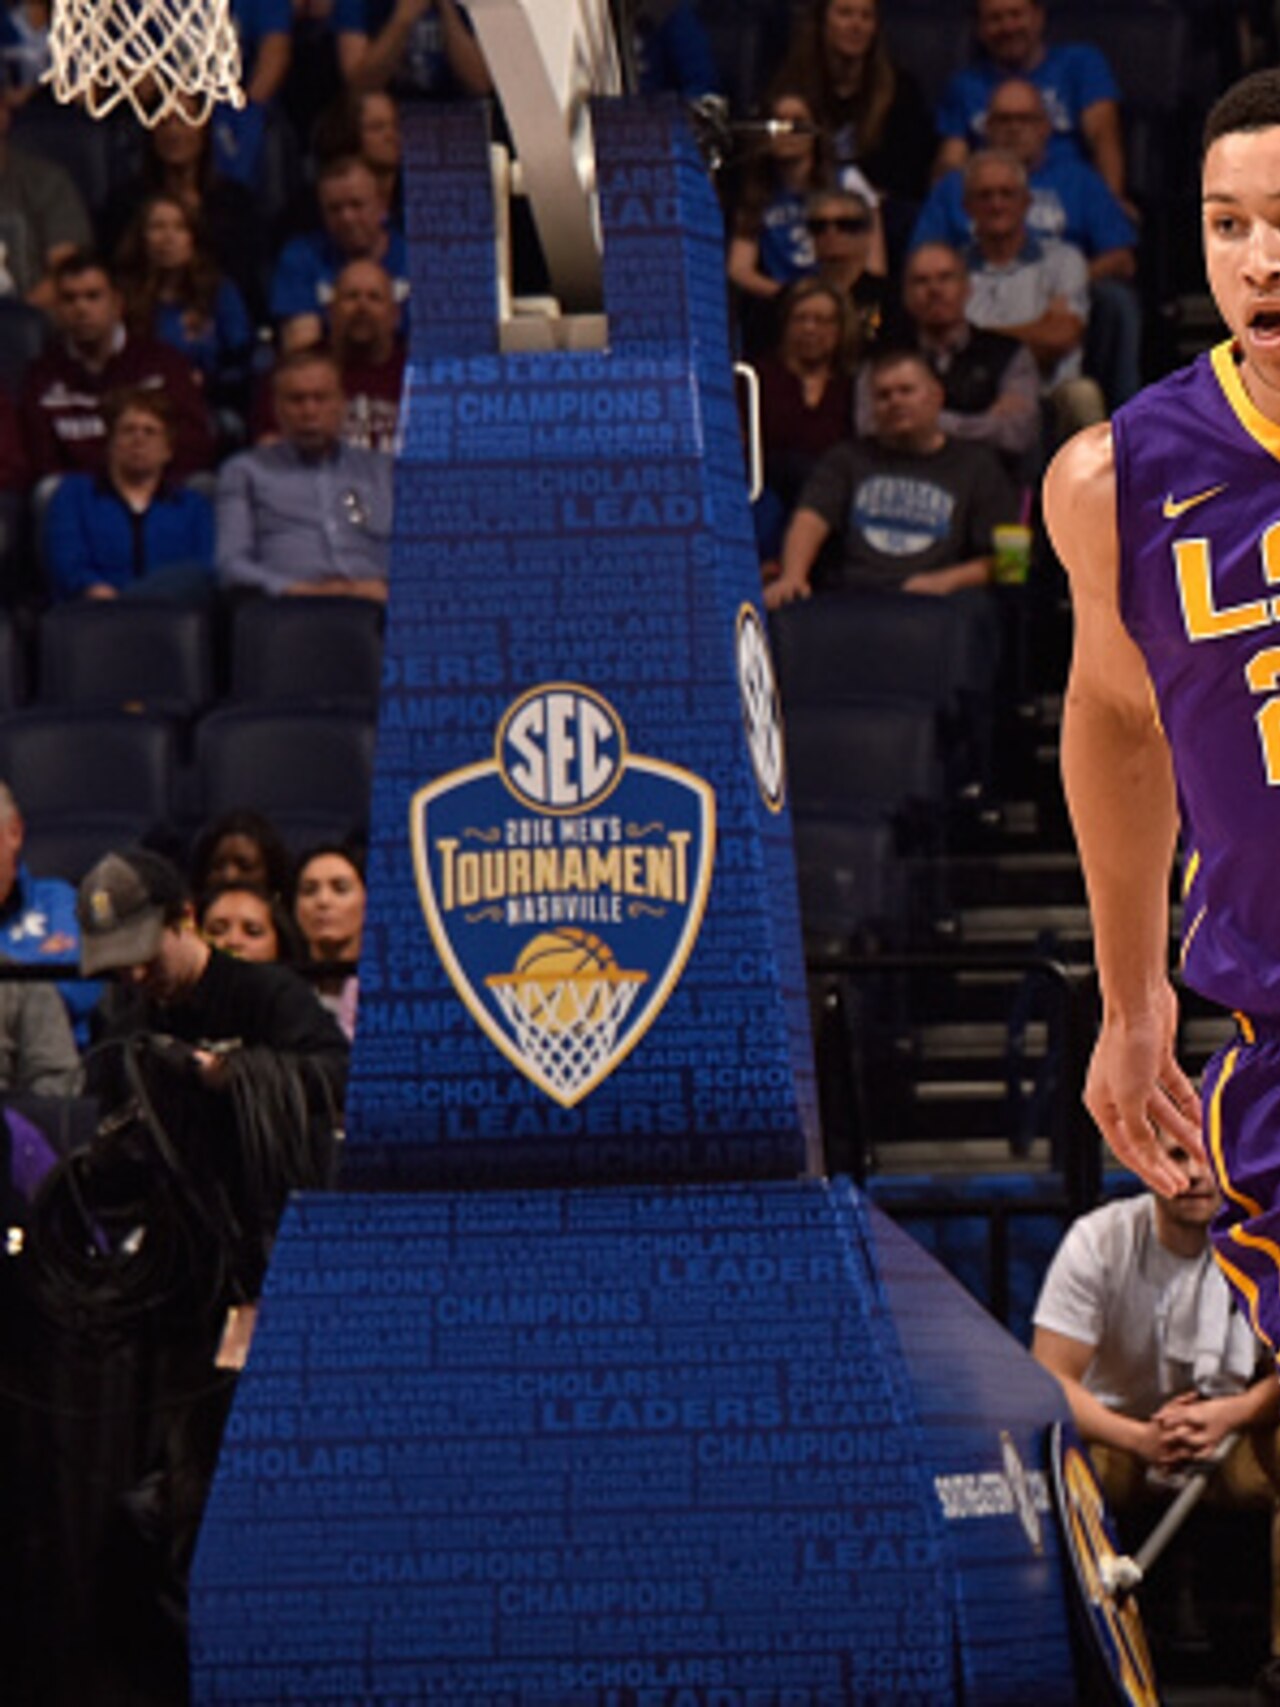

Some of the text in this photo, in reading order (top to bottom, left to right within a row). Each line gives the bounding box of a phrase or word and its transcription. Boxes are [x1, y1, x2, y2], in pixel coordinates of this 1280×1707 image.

[456, 387, 662, 424] CHAMPIONS
[506, 693, 614, 806] SEC
[506, 815, 622, 846] 2016 MEN'S
[436, 831, 691, 911] TOURNAMENT
[506, 894, 623, 926] NASHVILLE
[447, 1102, 688, 1138] LEADERS
[263, 1269, 445, 1297] CHAMPIONS
[436, 1293, 644, 1325] CHAMPIONS
[498, 1369, 661, 1400] SCHOLARS
[541, 1397, 782, 1432] LEADERS
[346, 1551, 559, 1583] CHAMPIONS
[500, 1580, 705, 1615] CHAMPIONS
[558, 1658, 724, 1688] SCHOLARS
